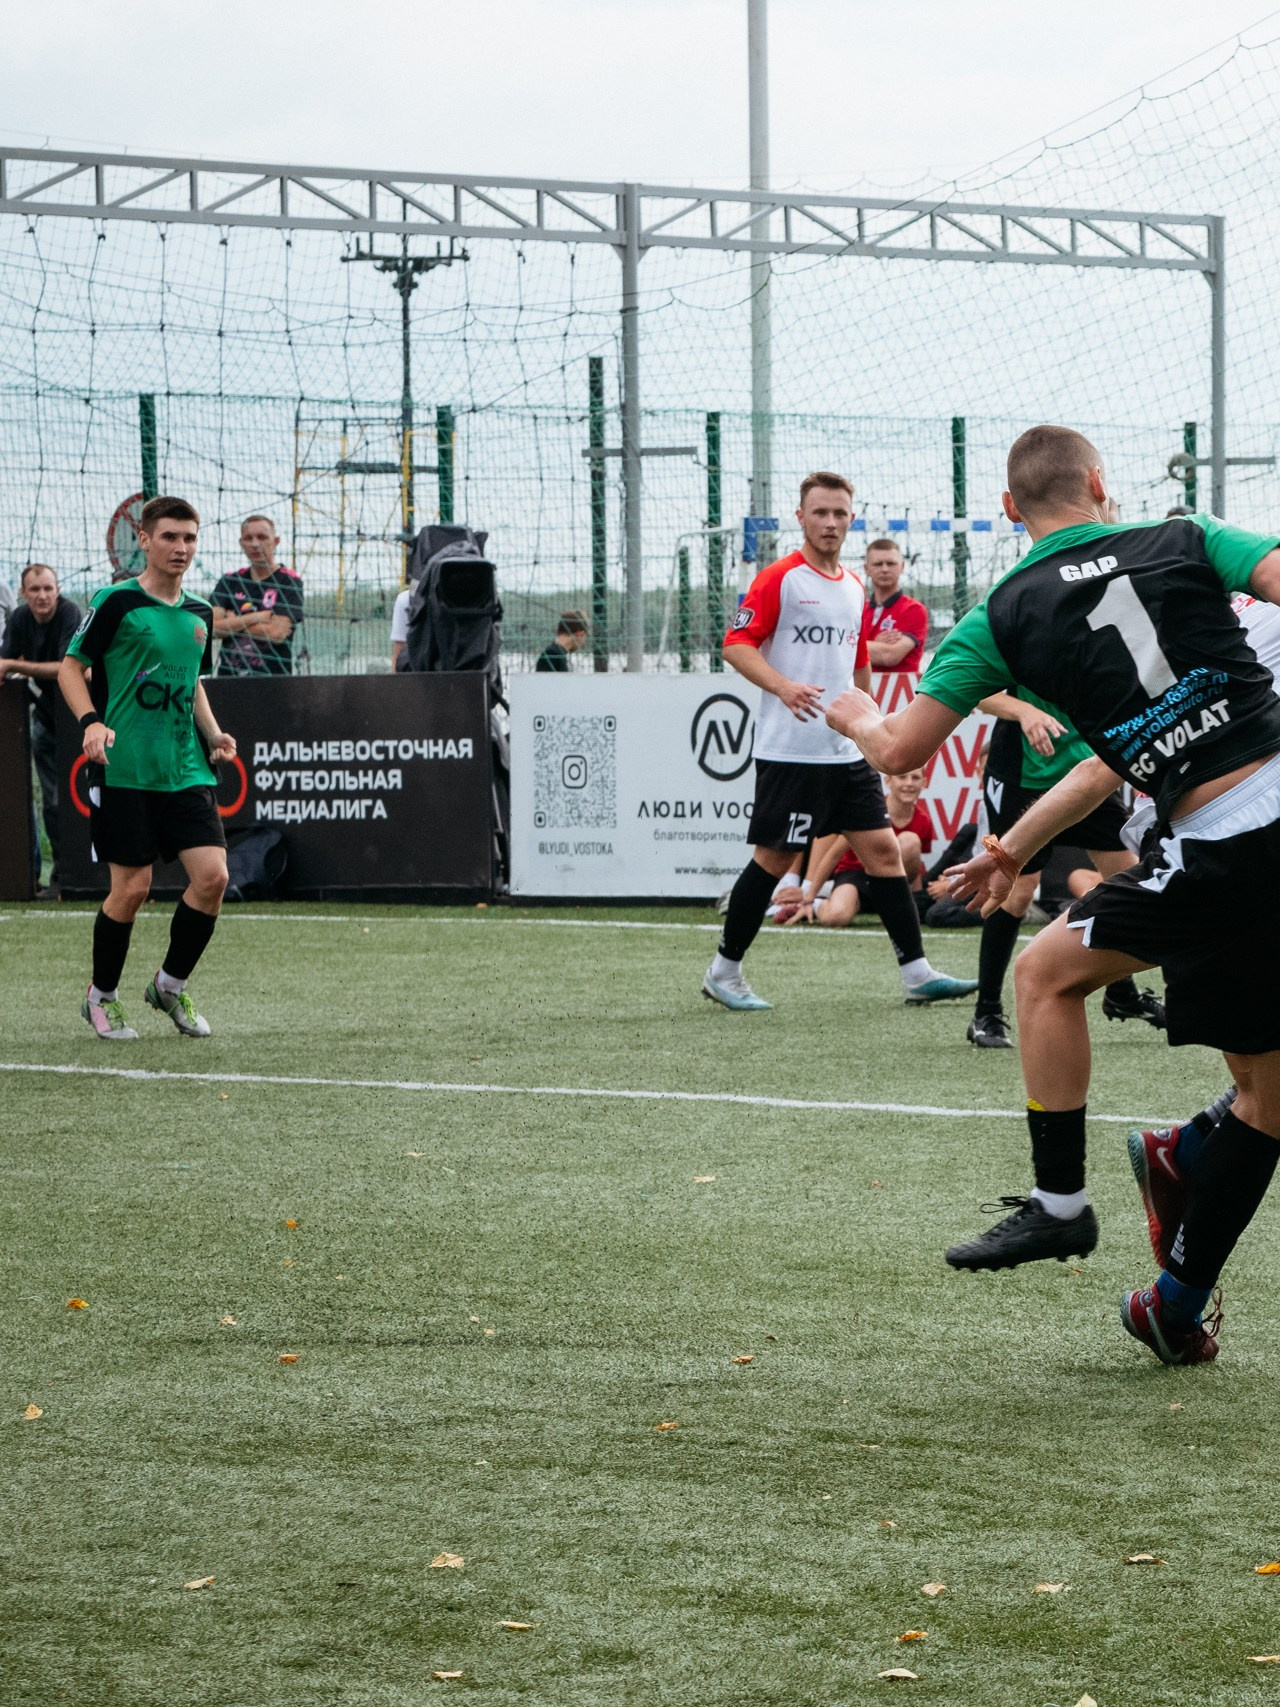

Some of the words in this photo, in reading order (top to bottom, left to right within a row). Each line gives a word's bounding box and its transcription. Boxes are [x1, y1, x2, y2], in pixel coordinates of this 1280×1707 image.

[1059, 555, 1118, 582] GAP
[1086, 574, 1179, 700] 1
[253, 738, 473, 766] ДАЛЬНЕВОСТОЧНАЯ
[1129, 752, 1156, 782] FC
[1153, 699, 1231, 757] VOLAT
[254, 768, 402, 791] ФУТБОЛЬНАЯ
[255, 799, 388, 823] МЕДИАЛИГА
[653, 829, 747, 842] благотворительн
[786, 812, 813, 844] 12
[675, 866, 743, 876] www.людивос
